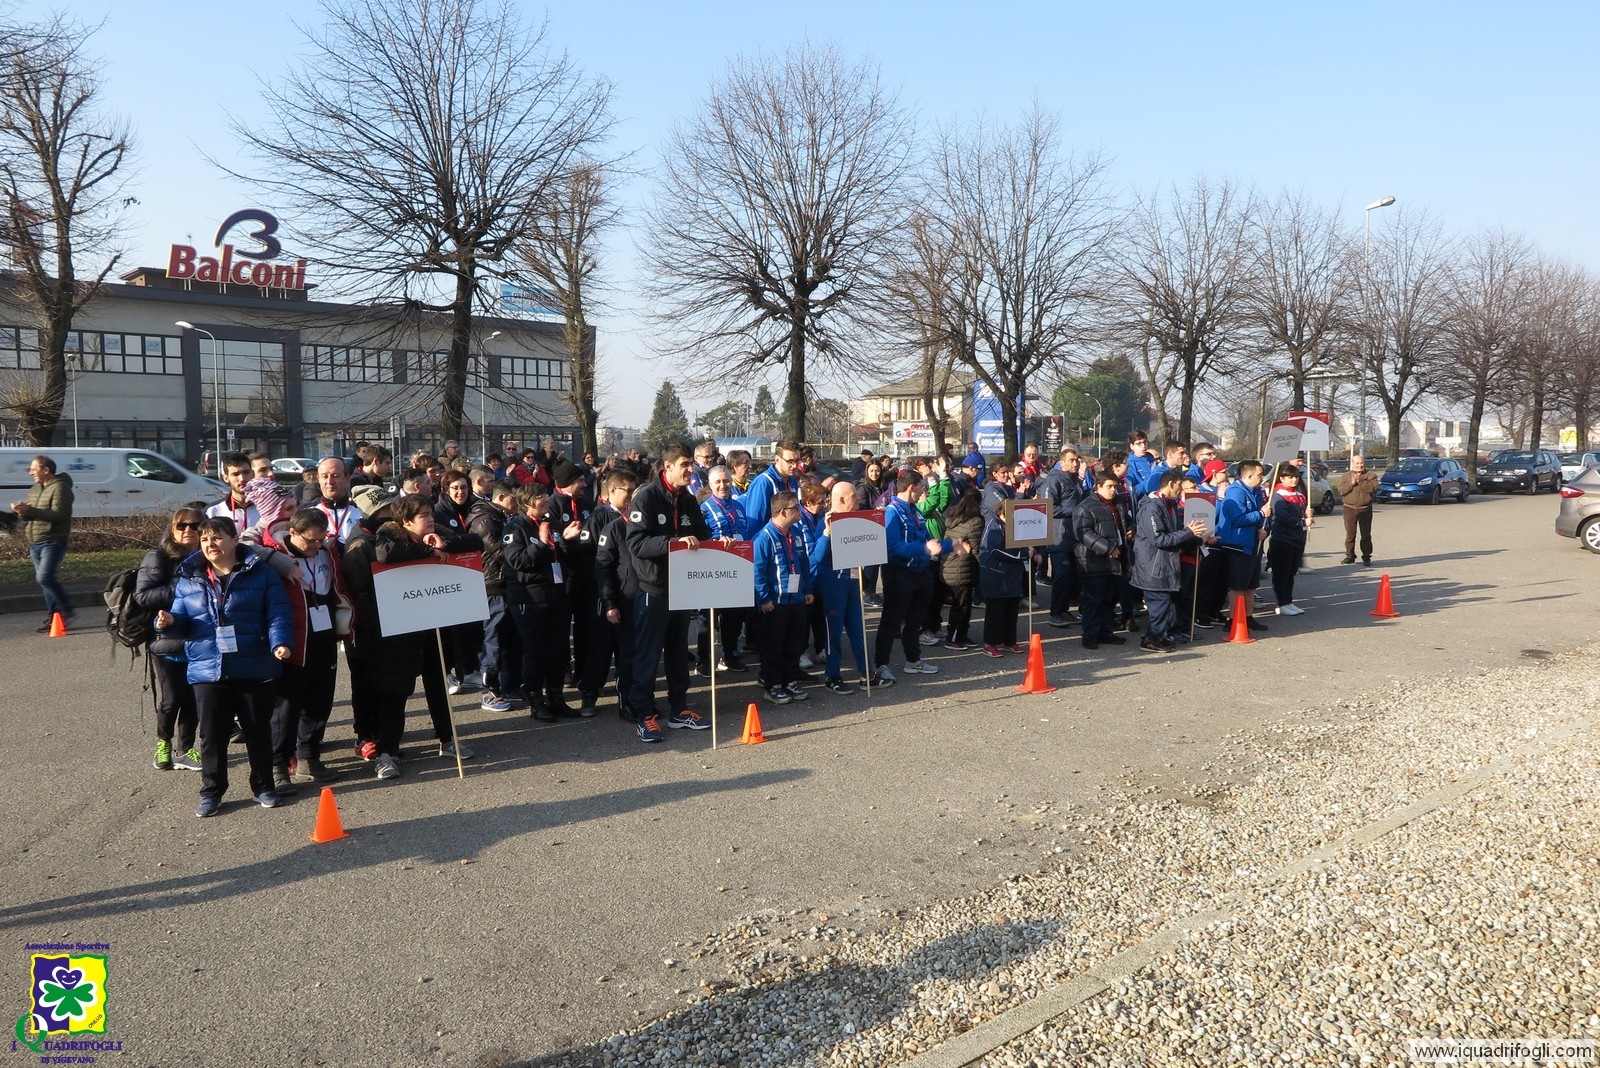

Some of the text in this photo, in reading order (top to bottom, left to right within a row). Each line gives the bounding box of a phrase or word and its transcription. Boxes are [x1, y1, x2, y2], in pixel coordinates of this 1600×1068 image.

[166, 244, 307, 290] Balconi
[687, 570, 738, 580] BRIXIA SMILE
[402, 583, 463, 601] ASA VARESE
